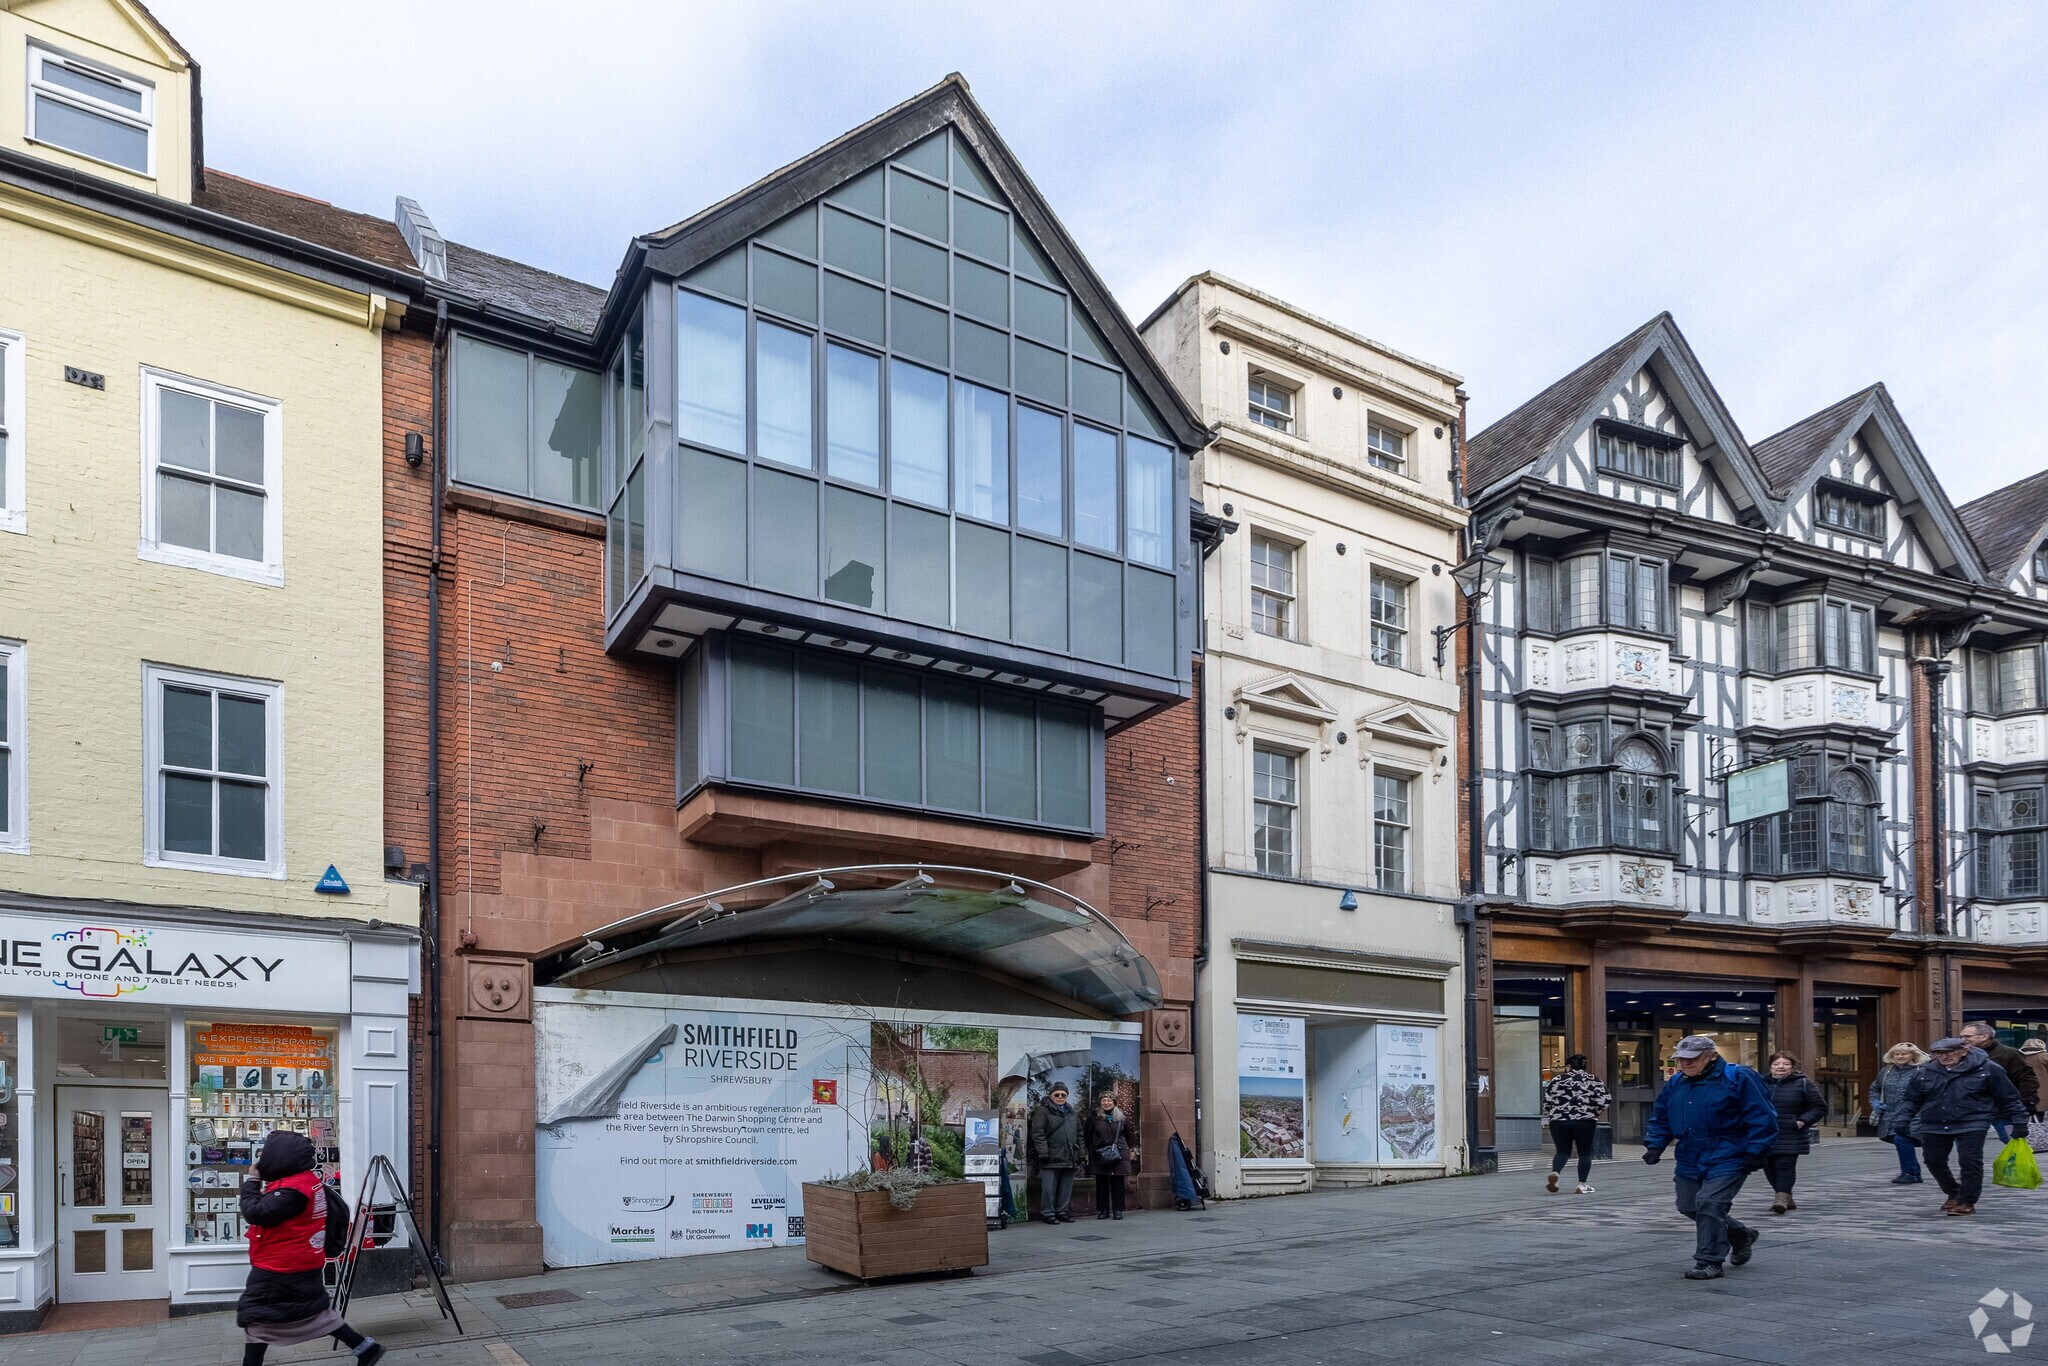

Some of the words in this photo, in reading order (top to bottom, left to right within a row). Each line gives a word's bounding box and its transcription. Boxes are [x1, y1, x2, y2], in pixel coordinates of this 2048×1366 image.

[66, 944, 285, 982] GALAXY
[24, 969, 62, 979] YOUR
[65, 971, 109, 982] PHONE
[114, 975, 141, 984] AND
[145, 976, 190, 987] TABLET
[195, 980, 237, 989] NEEDS!
[215, 1025, 311, 1037] PROFESSIONAL
[1265, 1021, 1290, 1029] SMITHFIELD
[210, 1034, 270, 1044] EXPRESS
[273, 1037, 325, 1047] REPAIRS
[684, 1023, 798, 1050] SMITHFIELD
[198, 1055, 217, 1064] WE
[219, 1056, 242, 1065] BUY
[256, 1057, 280, 1066] SELL
[284, 1059, 328, 1068] PHONES
[685, 1048, 798, 1071] RIVERSIDE
[710, 1075, 773, 1085] SHREWSBURY
[618, 1100, 638, 1110] field
[640, 1101, 681, 1110] Riverside
[683, 1102, 690, 1111] is
[705, 1103, 748, 1112] ambitious
[749, 1105, 802, 1114] regeneration
[804, 1106, 822, 1115] plan
[623, 1112, 644, 1121] area
[646, 1112, 685, 1122] between
[687, 1113, 703, 1122] The
[705, 1113, 736, 1122] Darwin
[737, 1114, 777, 1125] Shopping
[778, 1115, 806, 1124] Centre
[807, 1116, 823, 1124] and
[606, 1123, 622, 1132] the
[623, 1123, 647, 1132] River
[648, 1123, 679, 1132] Severn
[681, 1123, 690, 1132] in
[691, 1124, 742, 1135] Shrewsbury
[744, 1126, 765, 1134] town
[766, 1127, 795, 1135] centre,
[796, 1126, 810, 1134] led
[663, 1135, 674, 1146] by
[675, 1135, 723, 1145] Shropshire
[724, 1136, 759, 1144] Council.
[620, 1156, 640, 1166] Find
[641, 1157, 658, 1165] out
[684, 1157, 695, 1165] at
[695, 1156, 798, 1166] smithfieldriverside.com
[631, 1196, 665, 1205] Shropshire
[751, 1197, 786, 1205] LEVELLING
[611, 1226, 655, 1235] Marches
[709, 1228, 716, 1236] by
[746, 1223, 773, 1239] RH
